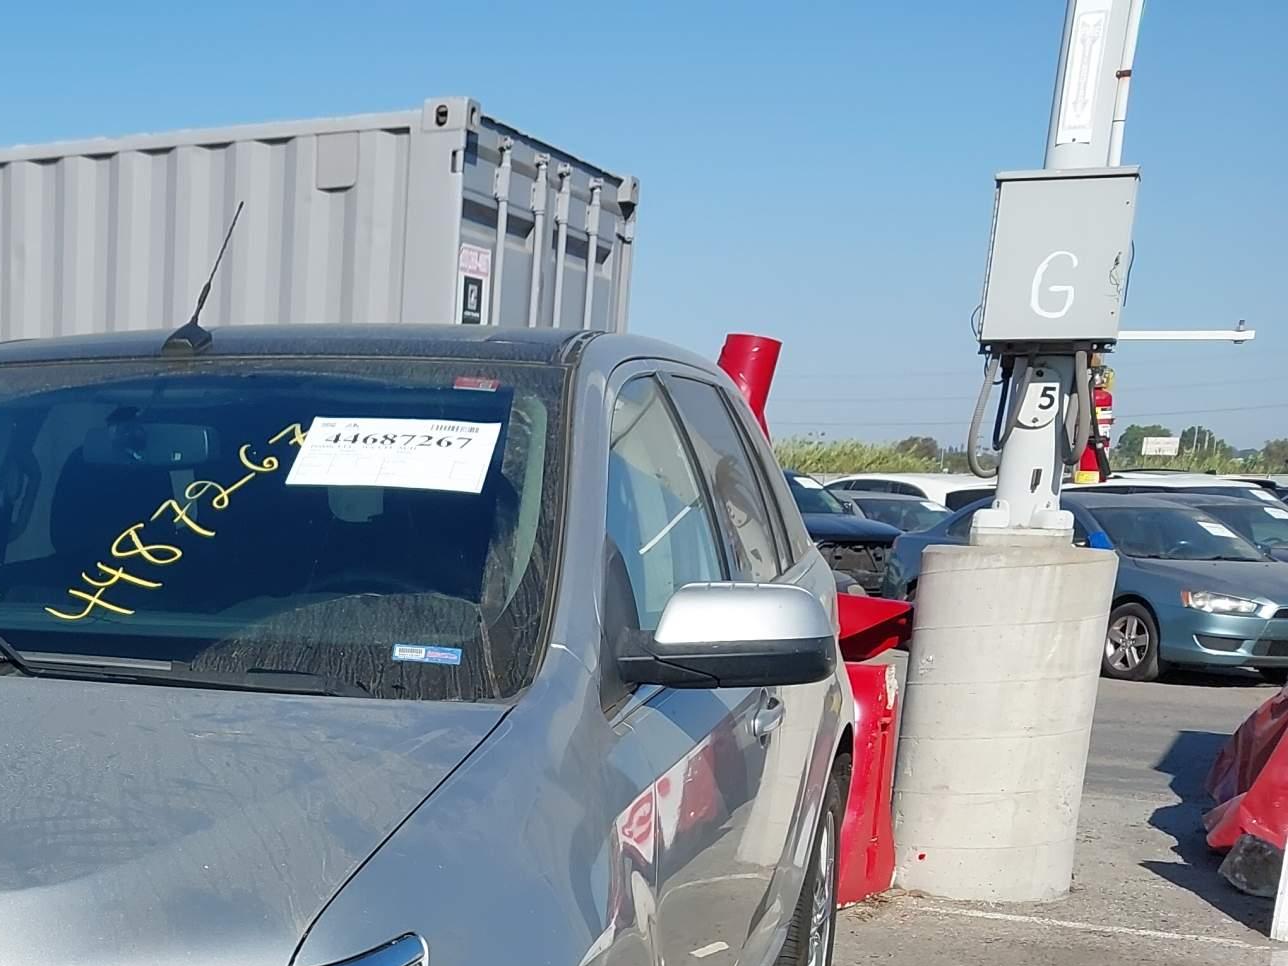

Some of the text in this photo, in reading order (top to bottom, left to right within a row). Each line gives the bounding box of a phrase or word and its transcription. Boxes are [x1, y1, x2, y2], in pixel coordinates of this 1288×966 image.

[1030, 251, 1078, 318] G
[1038, 386, 1056, 410] 5
[324, 432, 473, 449] 44687267
